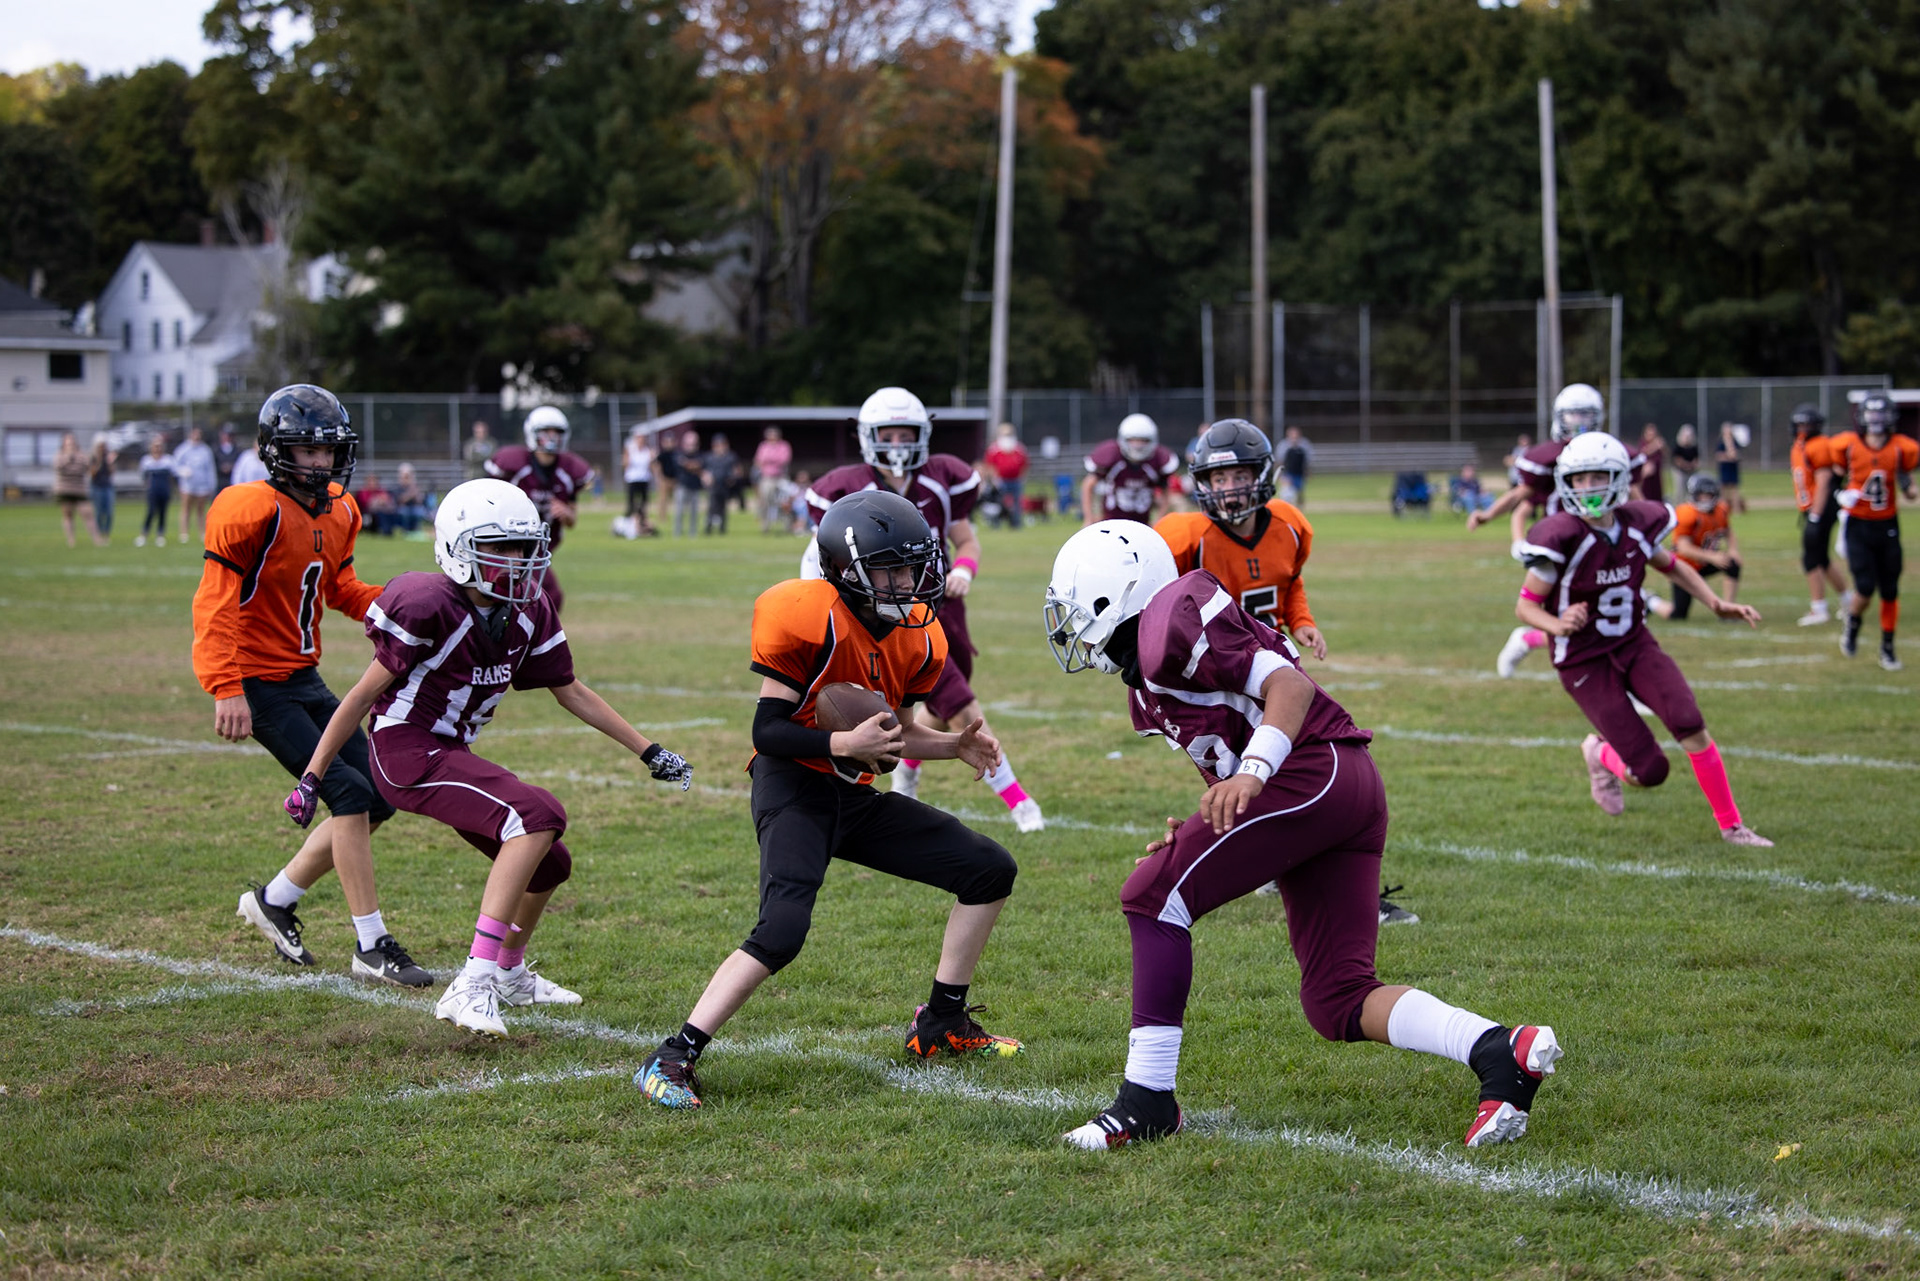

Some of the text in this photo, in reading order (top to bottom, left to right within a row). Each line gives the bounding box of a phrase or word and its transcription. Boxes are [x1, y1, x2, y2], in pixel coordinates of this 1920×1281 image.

[1859, 469, 1889, 511] 4
[312, 529, 323, 552] U
[1246, 558, 1261, 580] U
[1595, 564, 1632, 585] RAMS
[297, 561, 324, 654] 1
[1240, 585, 1278, 627] 5
[1594, 585, 1635, 637] 9
[471, 663, 513, 685] RAMS
[868, 652, 880, 680] U
